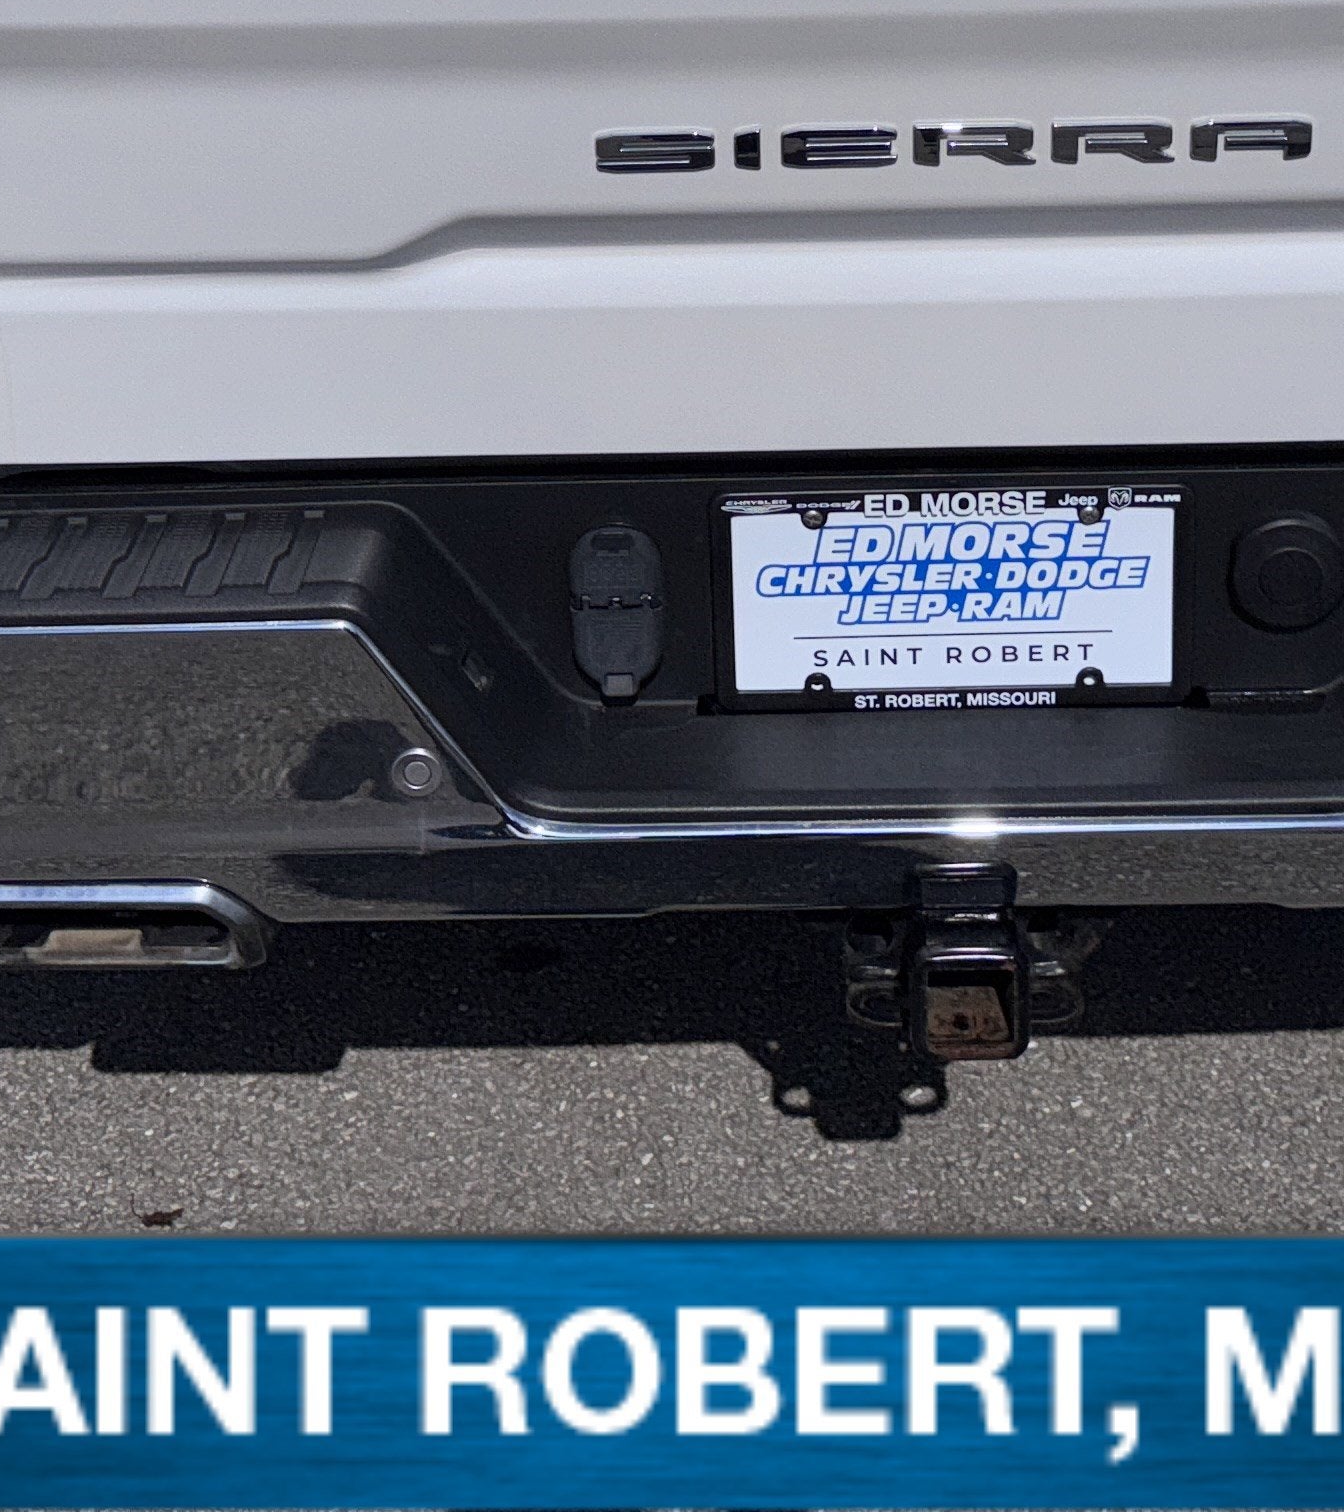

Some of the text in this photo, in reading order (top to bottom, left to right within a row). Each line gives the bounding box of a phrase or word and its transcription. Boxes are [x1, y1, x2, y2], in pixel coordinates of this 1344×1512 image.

[595, 119, 1313, 173] SIERRA
[725, 499, 788, 507] CHRYSLER
[864, 490, 1047, 518] ED MORSE
[1058, 492, 1099, 508] Jeep
[1133, 494, 1182, 504] RAM
[813, 520, 1110, 565] ED MORSE
[813, 644, 1094, 667] SAINT ROBERT
[854, 691, 1056, 709] ST. ROBERT, MISSOURI
